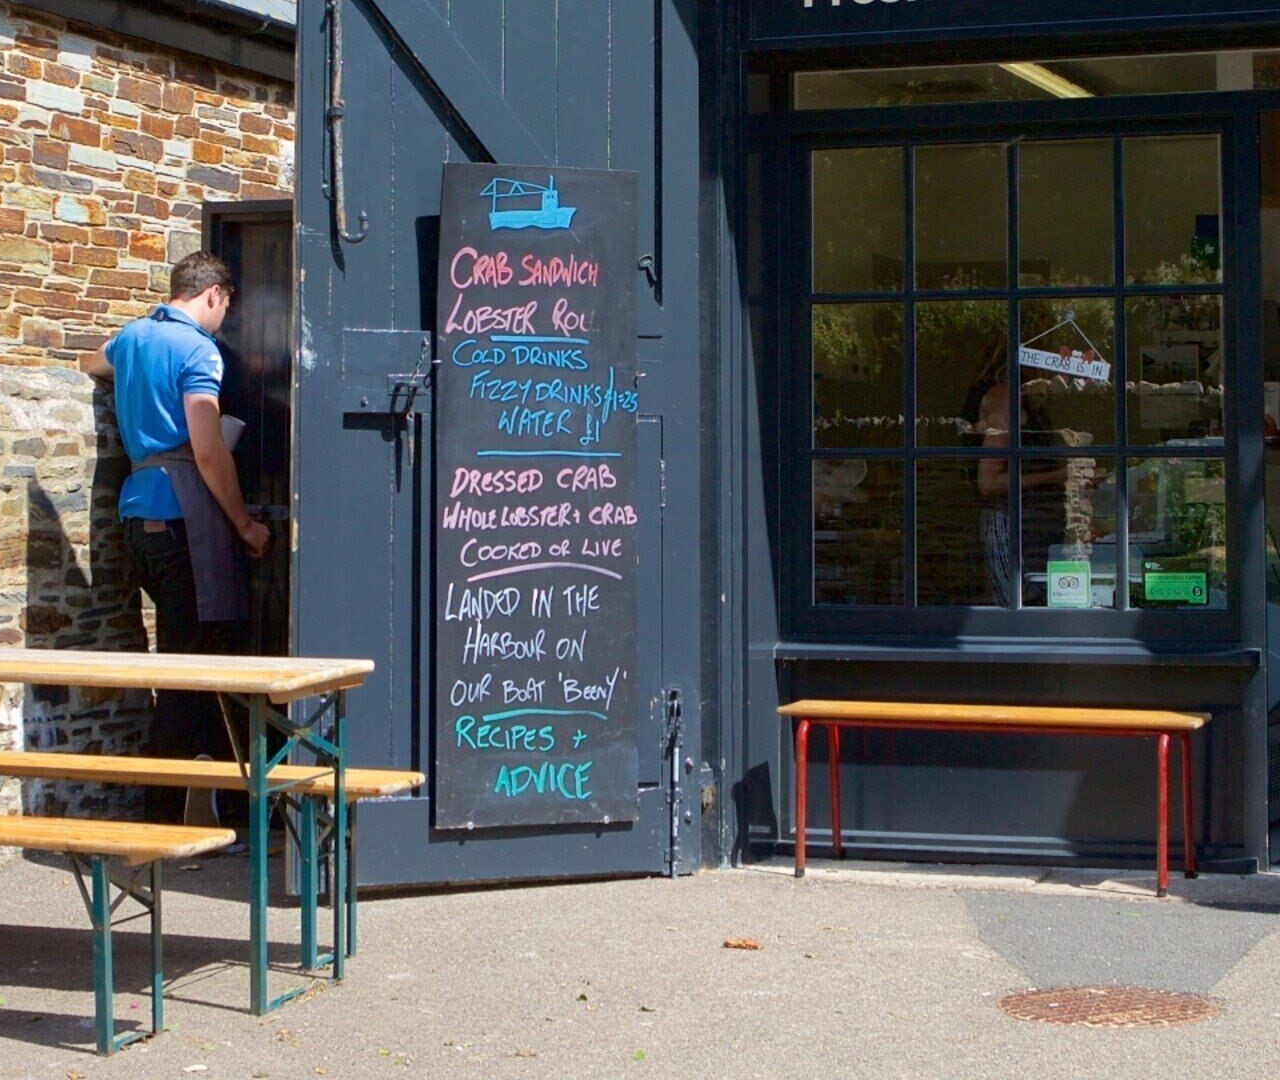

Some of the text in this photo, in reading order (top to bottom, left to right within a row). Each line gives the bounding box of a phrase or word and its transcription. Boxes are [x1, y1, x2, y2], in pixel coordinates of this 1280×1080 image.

[451, 247, 600, 289] CRAB SANDWICH
[445, 293, 538, 335] LOBSTER
[452, 340, 589, 370] COLD DRINKS
[1022, 350, 1103, 377] THE CRAB IS IN
[470, 370, 534, 402] FIZZY
[535, 378, 602, 407] DRINKS
[498, 406, 600, 446] WATER £1
[450, 464, 617, 498] DRESSED CRAB
[442, 501, 497, 532] WHOLE
[501, 503, 571, 528] LOBSTER
[588, 503, 638, 525] CRAB
[460, 538, 622, 568] COOKED OR LIVE
[444, 582, 600, 621] LANDED IN THE
[1194, 587, 1201, 596] 5
[462, 619, 587, 665] HARBOUR ON
[450, 673, 492, 706] OUR
[503, 677, 546, 704] BOAT
[456, 716, 587, 751] RECIPES +
[494, 761, 593, 800] ADVICE
